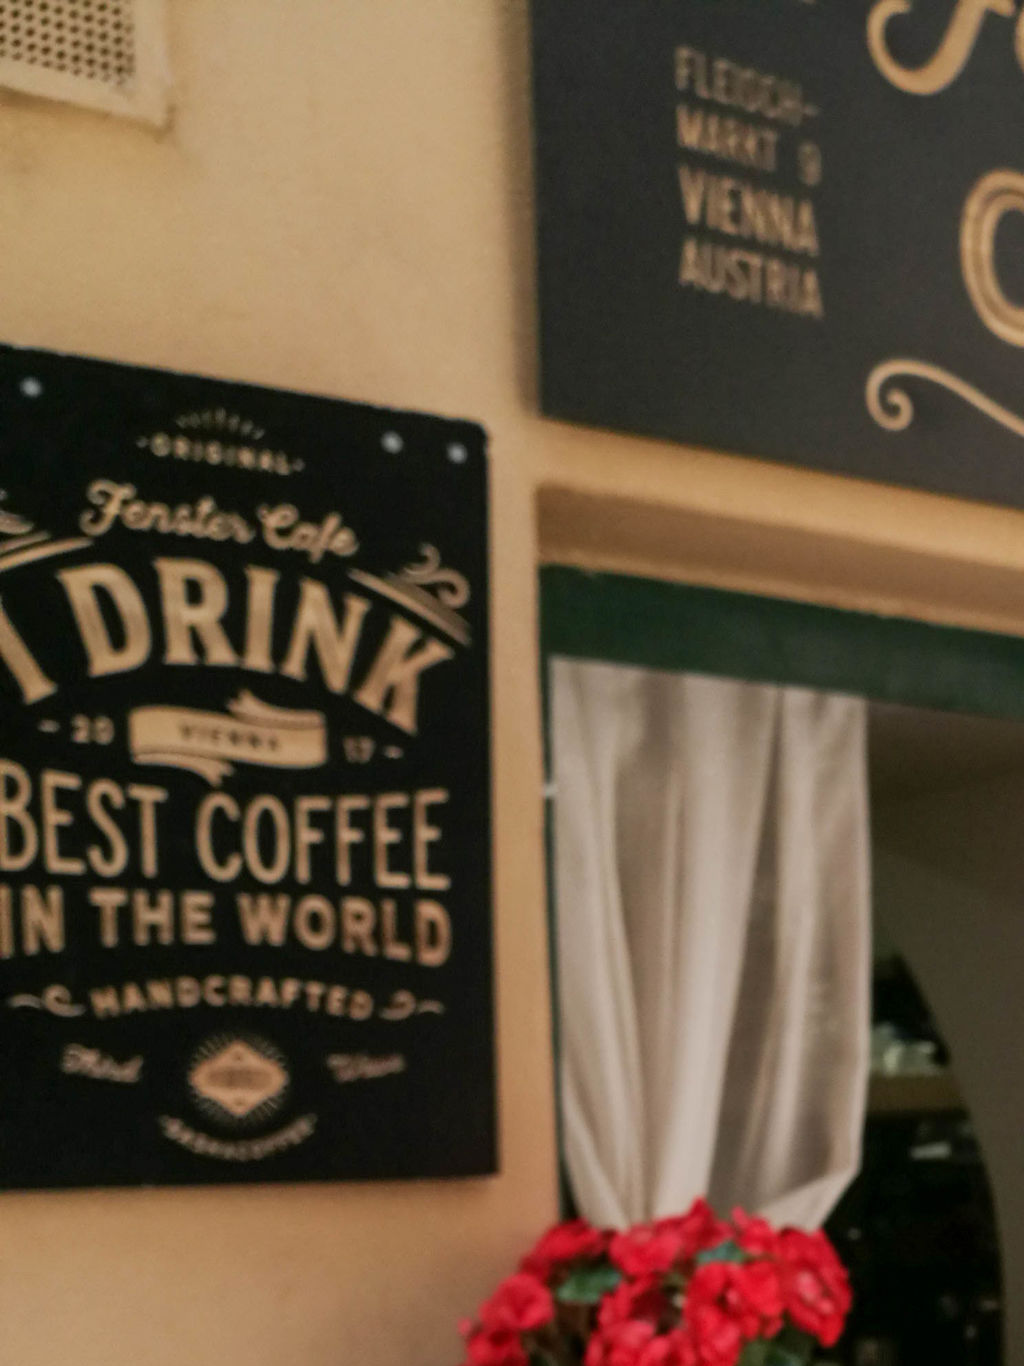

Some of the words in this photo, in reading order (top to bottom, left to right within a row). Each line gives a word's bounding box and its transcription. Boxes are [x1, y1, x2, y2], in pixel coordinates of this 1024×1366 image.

[678, 163, 820, 258] VIENNA
[679, 237, 825, 320] AUSTRIA
[79, 479, 255, 545] Fenster
[56, 556, 456, 736] DRINK
[0, 758, 168, 879] BEST
[196, 788, 452, 891] COFFEE
[0, 884, 66, 960] IN
[89, 888, 217, 949] THE
[236, 892, 453, 968] WORLD
[89, 974, 375, 1021] HANDCRAFTED
